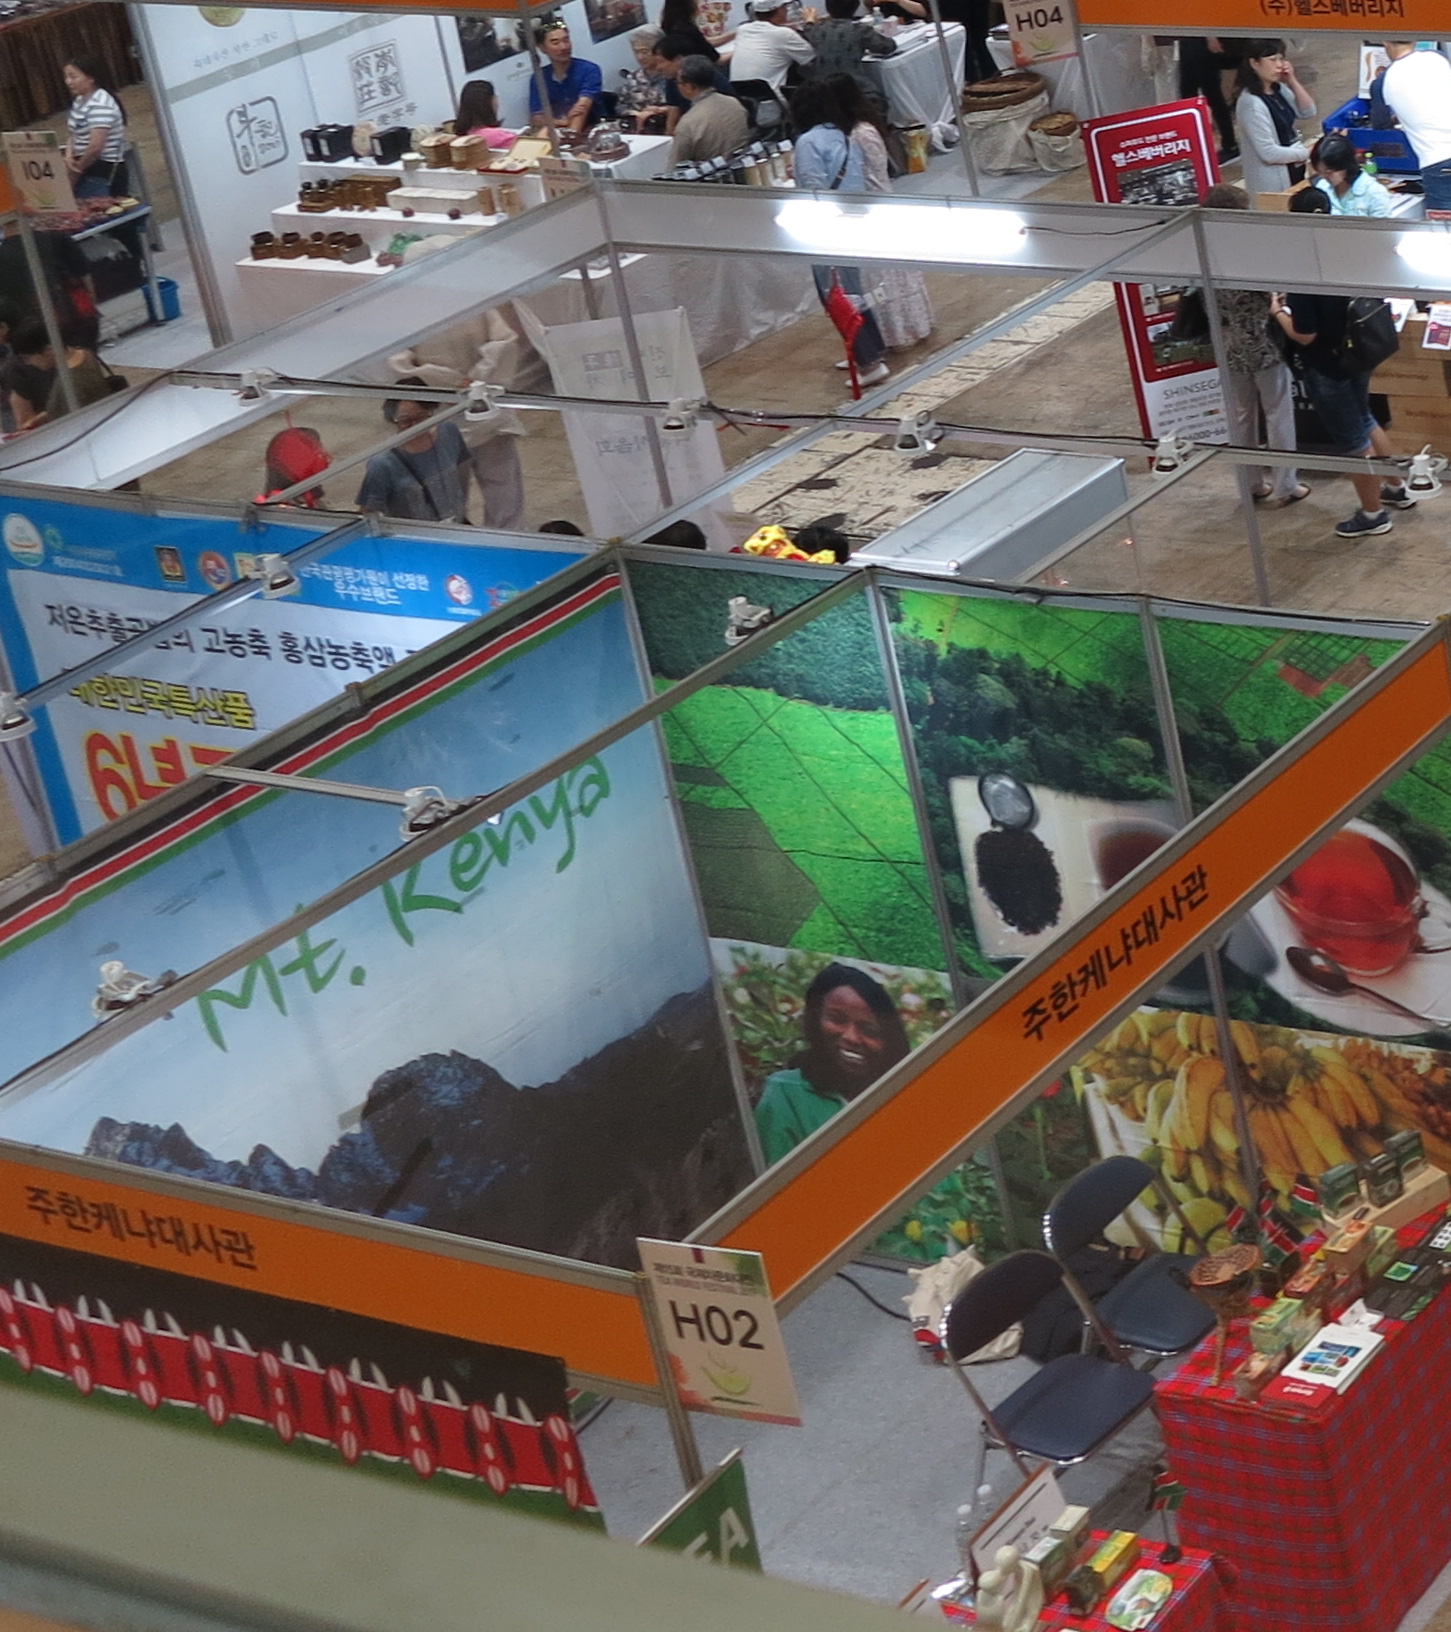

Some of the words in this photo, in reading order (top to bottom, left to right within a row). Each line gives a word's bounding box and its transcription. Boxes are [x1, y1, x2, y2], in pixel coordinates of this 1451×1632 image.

[1014, 5, 1064, 33] H04
[1110, 138, 1193, 167] 헬스베버리지
[333, 582, 402, 606] 우수브랜드
[201, 625, 273, 663] 고농축
[279, 633, 396, 673] 홍삼농축액
[384, 753, 611, 947] Kenya
[195, 905, 369, 1052] Mt.
[1020, 864, 1210, 1046] 주한케냐대사관
[25, 1182, 259, 1271] 주한케냐대사관
[668, 1299, 764, 1351] H02
